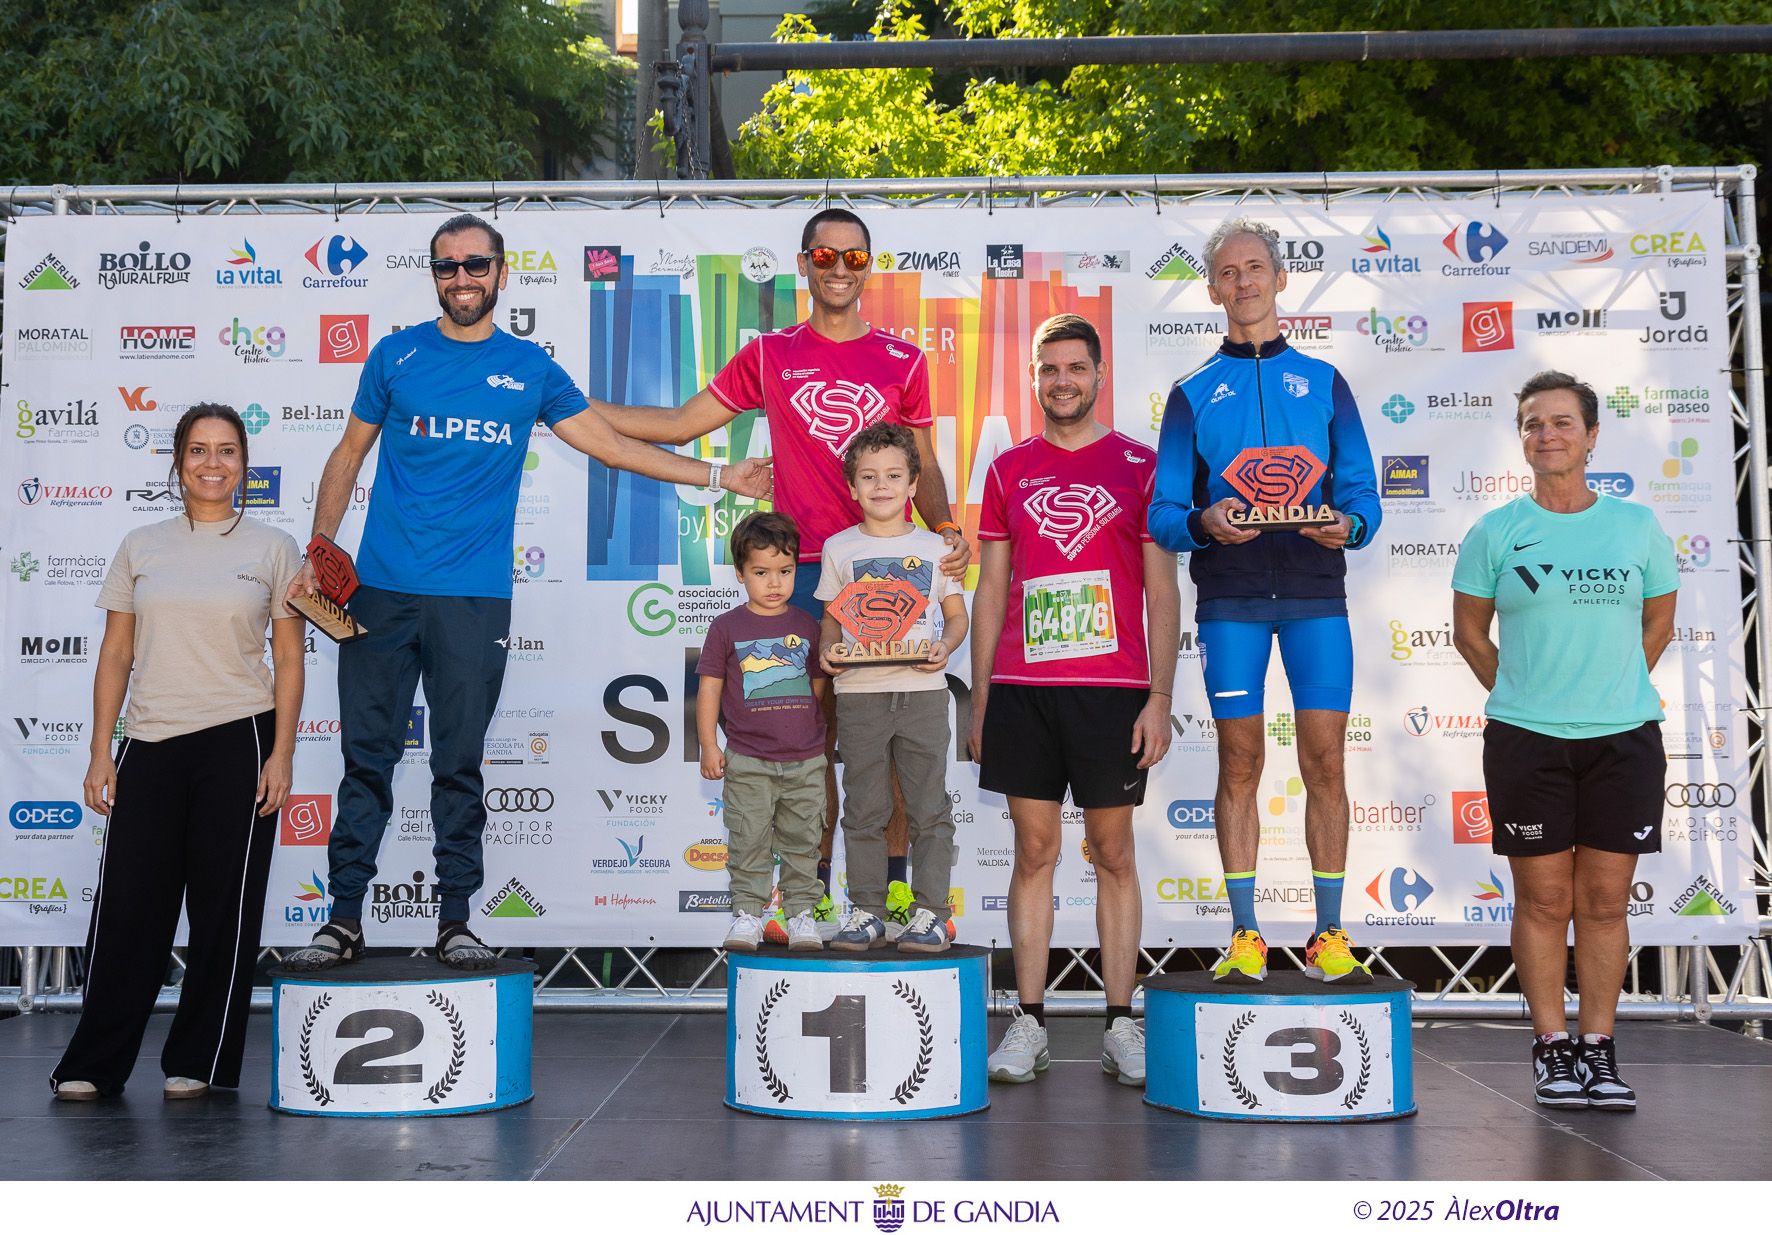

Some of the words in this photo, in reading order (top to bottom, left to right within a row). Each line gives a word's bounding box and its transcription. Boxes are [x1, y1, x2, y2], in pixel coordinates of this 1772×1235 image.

[1528, 239, 1608, 257] SANDEMI
[1630, 231, 1706, 254] CREA
[386, 255, 431, 269] SAND
[503, 250, 558, 271] REA
[896, 252, 960, 271] ZUMBA
[987, 256, 999, 268] La
[1146, 248, 1177, 279] LEROY
[1171, 243, 1207, 280] MERLIN
[1376, 257, 1422, 273] vital
[18, 259, 49, 289] LEROY
[45, 253, 81, 289] MERLIN
[240, 267, 282, 285] vital
[1442, 264, 1511, 277] Carrefour
[98, 271, 191, 290] NATURALFRUIT
[303, 276, 368, 289] Carrefour
[1537, 309, 1601, 330] Moll
[18, 329, 89, 341] MORATAL
[1149, 323, 1223, 335] MORATAL
[122, 328, 193, 350] HOME
[18, 341, 89, 352] PALOMINO
[1644, 385, 1710, 400] farmacia
[1644, 401, 1663, 414] del
[1667, 402, 1711, 417] paseo
[16, 399, 99, 439] gavilá
[410, 415, 513, 445] ALPESA
[1390, 469, 1418, 480] AIMAR
[1452, 471, 1533, 494] J.barbe
[43, 485, 113, 500] VIMACO
[1653, 493, 1712, 503] ortoaqua
[49, 499, 103, 508] Refrigeración
[1227, 503, 1336, 524] GANDIA
[676, 508, 704, 543] by
[1080, 524, 1102, 547] PERSONA
[1098, 505, 1124, 527] SOLIDARIA
[47, 554, 106, 568] farmàcia
[47, 567, 63, 578] del
[70, 566, 103, 578] raval
[1560, 567, 1631, 582] VICKY
[678, 586, 739, 599] asociación
[1569, 583, 1626, 595] FOODS
[677, 598, 731, 611] española
[1572, 598, 1621, 606] ATHLETICS
[310, 591, 355, 631] ANDIA
[678, 613, 713, 623] contra
[1029, 602, 1109, 639] 64876
[21, 636, 82, 656] Moll
[1390, 620, 1454, 661] gavi
[830, 638, 932, 658] GANDIA
[528, 707, 555, 719] Giner
[41, 721, 84, 733] VICKY
[1434, 714, 1488, 730] VIMA
[45, 734, 80, 742] FOODS
[1441, 729, 1484, 739] Refrigera
[22, 746, 71, 755] FUNDACIÓN
[487, 742, 513, 750] ESCOLA
[626, 794, 668, 805] VICKY
[15, 808, 75, 824] ODEC
[400, 806, 432, 819] farm
[629, 806, 664, 814] FOODS
[1174, 806, 1216, 823] ODE
[400, 820, 424, 833] del
[485, 821, 553, 832] MOTOR
[606, 818, 656, 828] FUNDACIÓN
[1518, 823, 1544, 833] VICKY
[1668, 816, 1737, 828] MOTOR
[15, 833, 30, 842] your
[31, 832, 47, 840] data
[47, 832, 75, 842] partner
[485, 831, 553, 845] PACÍFICO
[1175, 833, 1192, 841] your
[1192, 832, 1209, 840] data
[1668, 828, 1738, 842] PACÍFICO
[592, 858, 628, 868] VERDEJO
[638, 858, 671, 868] SEGURA
[977, 858, 1010, 867] VALDISA
[481, 886, 512, 916] LEROY
[508, 877, 547, 917] MERLIN
[610, 893, 657, 910] Hofmann
[1669, 883, 1701, 915] LEROY
[1696, 874, 1738, 915] MERLIN
[308, 905, 333, 923] vit
[371, 903, 440, 923] NATURALF
[1365, 913, 1437, 927] Carrefour
[1487, 905, 1513, 923] vit
[333, 1008, 425, 1085] 2
[801, 995, 867, 1093] 1
[1263, 1026, 1343, 1096] 3
